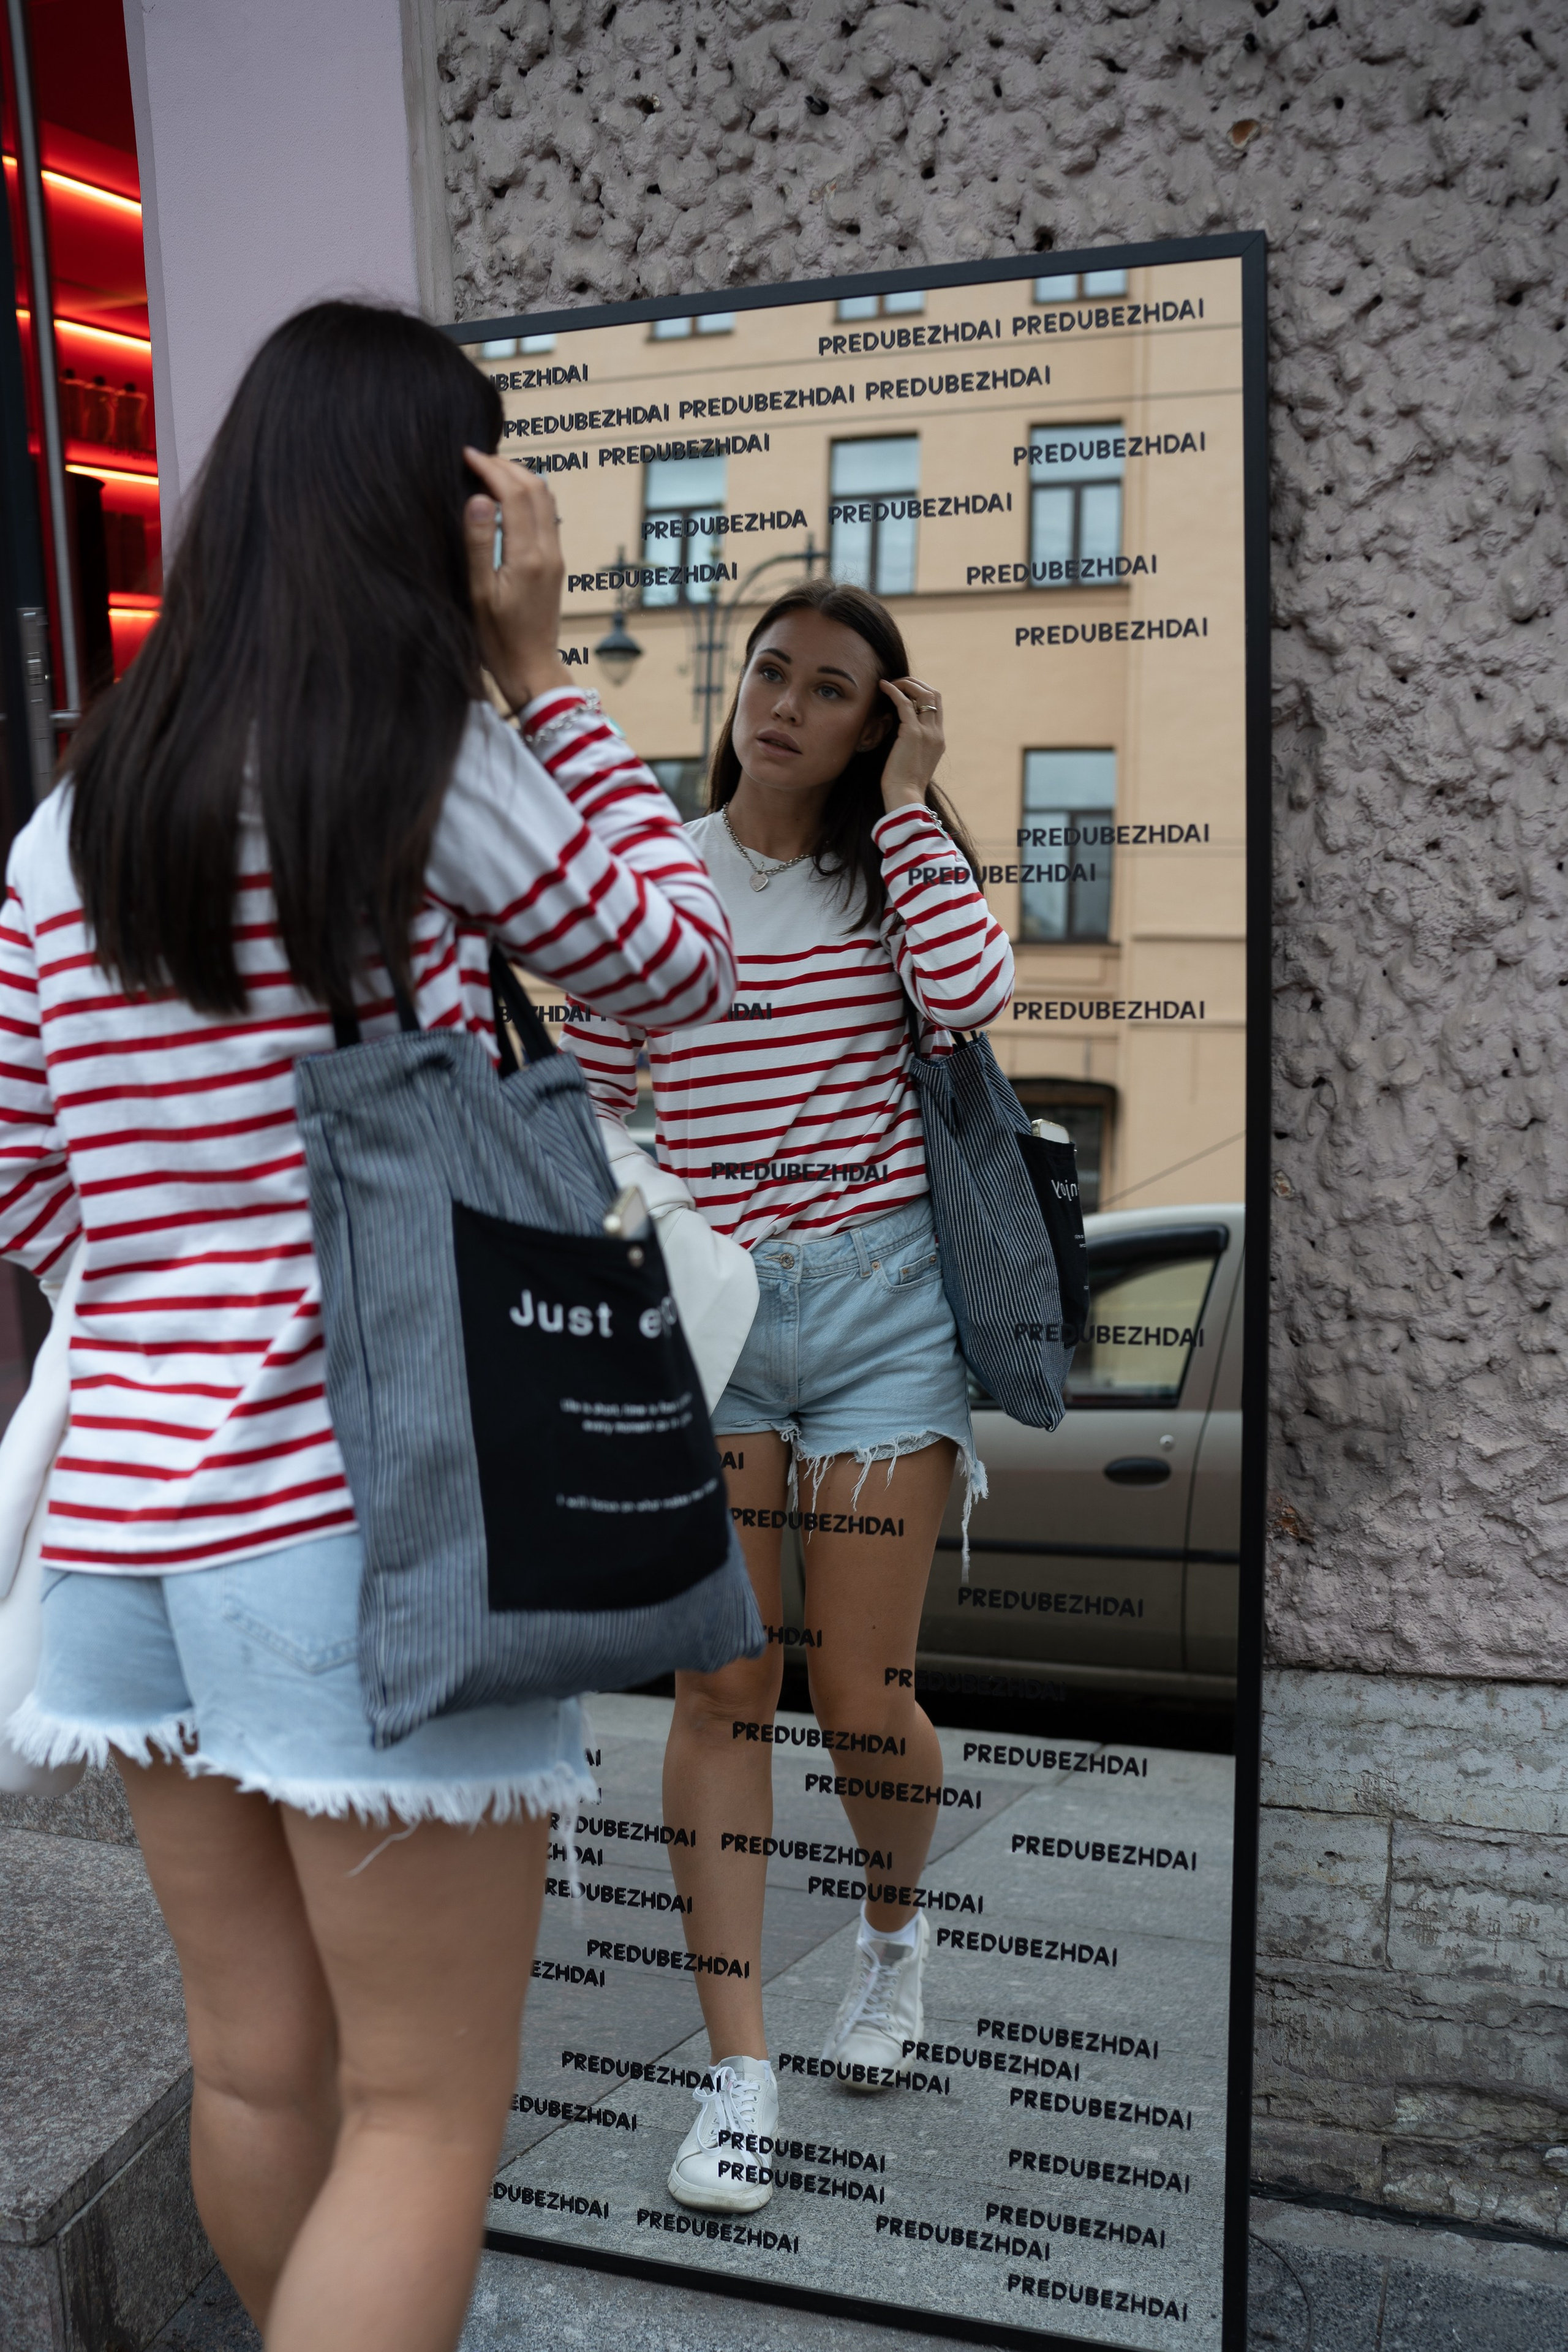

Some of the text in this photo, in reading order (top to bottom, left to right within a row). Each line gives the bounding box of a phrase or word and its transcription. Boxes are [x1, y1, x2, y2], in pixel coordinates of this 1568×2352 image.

[819, 298, 1204, 355] PREDUBEZHDAI PREDUBEZHDAI
[490, 363, 588, 390] BEZHDAI
[503, 366, 1050, 438] PREDUBEZHDAI PREDUBEZHDAI PREDUBEZHDAI
[599, 432, 770, 467] PREDUBEZHDAI
[1014, 432, 1205, 466] PREDUBEZHDAI
[641, 493, 1012, 540] PREDUBEZHDA PREDUBEZHDAI
[568, 562, 737, 592] PREDUBEZHDAI
[967, 555, 1157, 585] PREDUBEZHDAI
[1016, 617, 1208, 646] PREDUBEZHDAI
[1017, 824, 1209, 847] PREDUBEZHDAI
[908, 864, 1095, 886] PREDUBEZHDAI
[1013, 1001, 1205, 1020] PREDUBEZHDAI
[711, 1162, 888, 1182] PREDUBEZHDAI
[510, 1289, 612, 1338] Just
[1014, 1323, 1204, 1348] PREDUBEZHDAI
[731, 1507, 904, 1536] PREDUBEZHDAI
[959, 1586, 1143, 1618] PREDUBEZHDAI
[733, 1721, 905, 1755] PREDUBEZHDAI
[963, 1743, 1147, 1777] PREDUBEZHDAI
[805, 1773, 981, 1809] PREDUBEZHDAI
[550, 1811, 892, 1870] RDUBEZHDAI PREDUBEZHDAI
[1012, 1834, 1196, 1871] PREDUBEZHDAI
[545, 1877, 692, 1914] REDUBEZHDAI
[809, 1875, 983, 1914] PREDUBEZHDAI
[587, 1939, 749, 1978] PREDUBEZHDAI
[937, 1928, 1117, 1967] PREDUBEZHDAI
[530, 1959, 605, 1987] EZHDAI
[977, 2018, 1158, 2059] PREDUBEZHDAI
[562, 2051, 721, 2094] PREDUBEZHDAI
[779, 2053, 949, 2094] PREDUBEZHDAI
[902, 2040, 1079, 2081] PREDUBEZHDAI
[510, 2094, 637, 2132] EDUBEZHDAI
[1010, 2087, 1191, 2130] PREDUBEZHDAI
[718, 2130, 885, 2173] PREDUBEZHDAI
[1009, 2149, 1189, 2193] PREDUBEZHDAI
[489, 2180, 609, 2219] DUBEZHDAI
[718, 2160, 884, 2204] PREDUBEZHDAI
[637, 2208, 799, 2253] PREDUBEZHDAI
[875, 2214, 1049, 2261] PREDUBEZHDAI
[986, 2203, 1165, 2248] PREDUBEZHDAI
[1008, 2273, 1187, 2322] PREDUBEZHDAI
